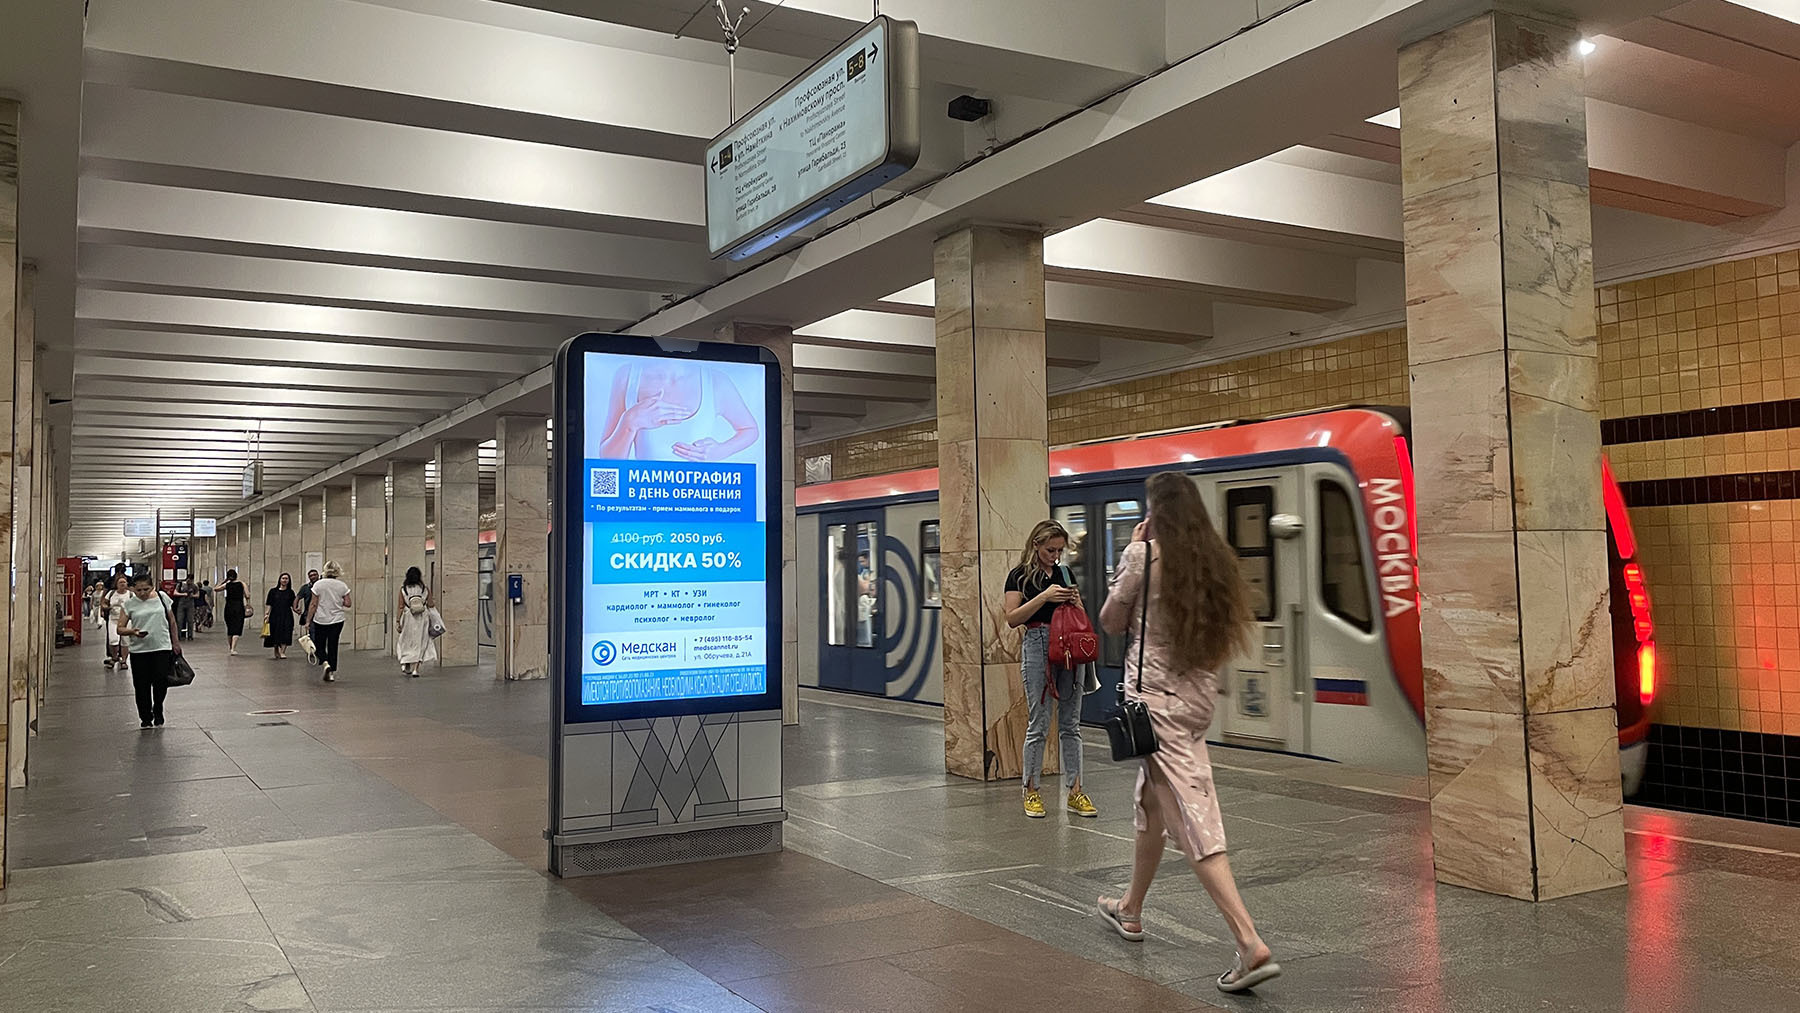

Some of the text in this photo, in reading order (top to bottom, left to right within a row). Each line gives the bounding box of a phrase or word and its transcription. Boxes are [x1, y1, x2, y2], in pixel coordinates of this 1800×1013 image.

[848, 54, 864, 76] 5-8
[795, 67, 845, 108] Профсоюзная ул.
[783, 94, 824, 128] Нахимовскому
[825, 81, 845, 99] просп.
[734, 116, 776, 151] Профсоюзная ул.
[798, 164, 811, 178] улица
[628, 469, 742, 485] МАММОГРАФИЯ
[628, 488, 742, 501] В ДЕНЬ ОБРАЩЕНИЯ
[610, 532, 726, 545] 4100 руб. 2050 руб.
[1369, 477, 1417, 618] МОСКВА
[610, 552, 742, 572] СКИДКА 50%
[644, 590, 708, 598] МРТ КТ УЗИ
[606, 600, 741, 612] кардиолог маммолог гинеколог
[634, 614, 715, 624] психолог невролог
[622, 642, 677, 655] Медскан
